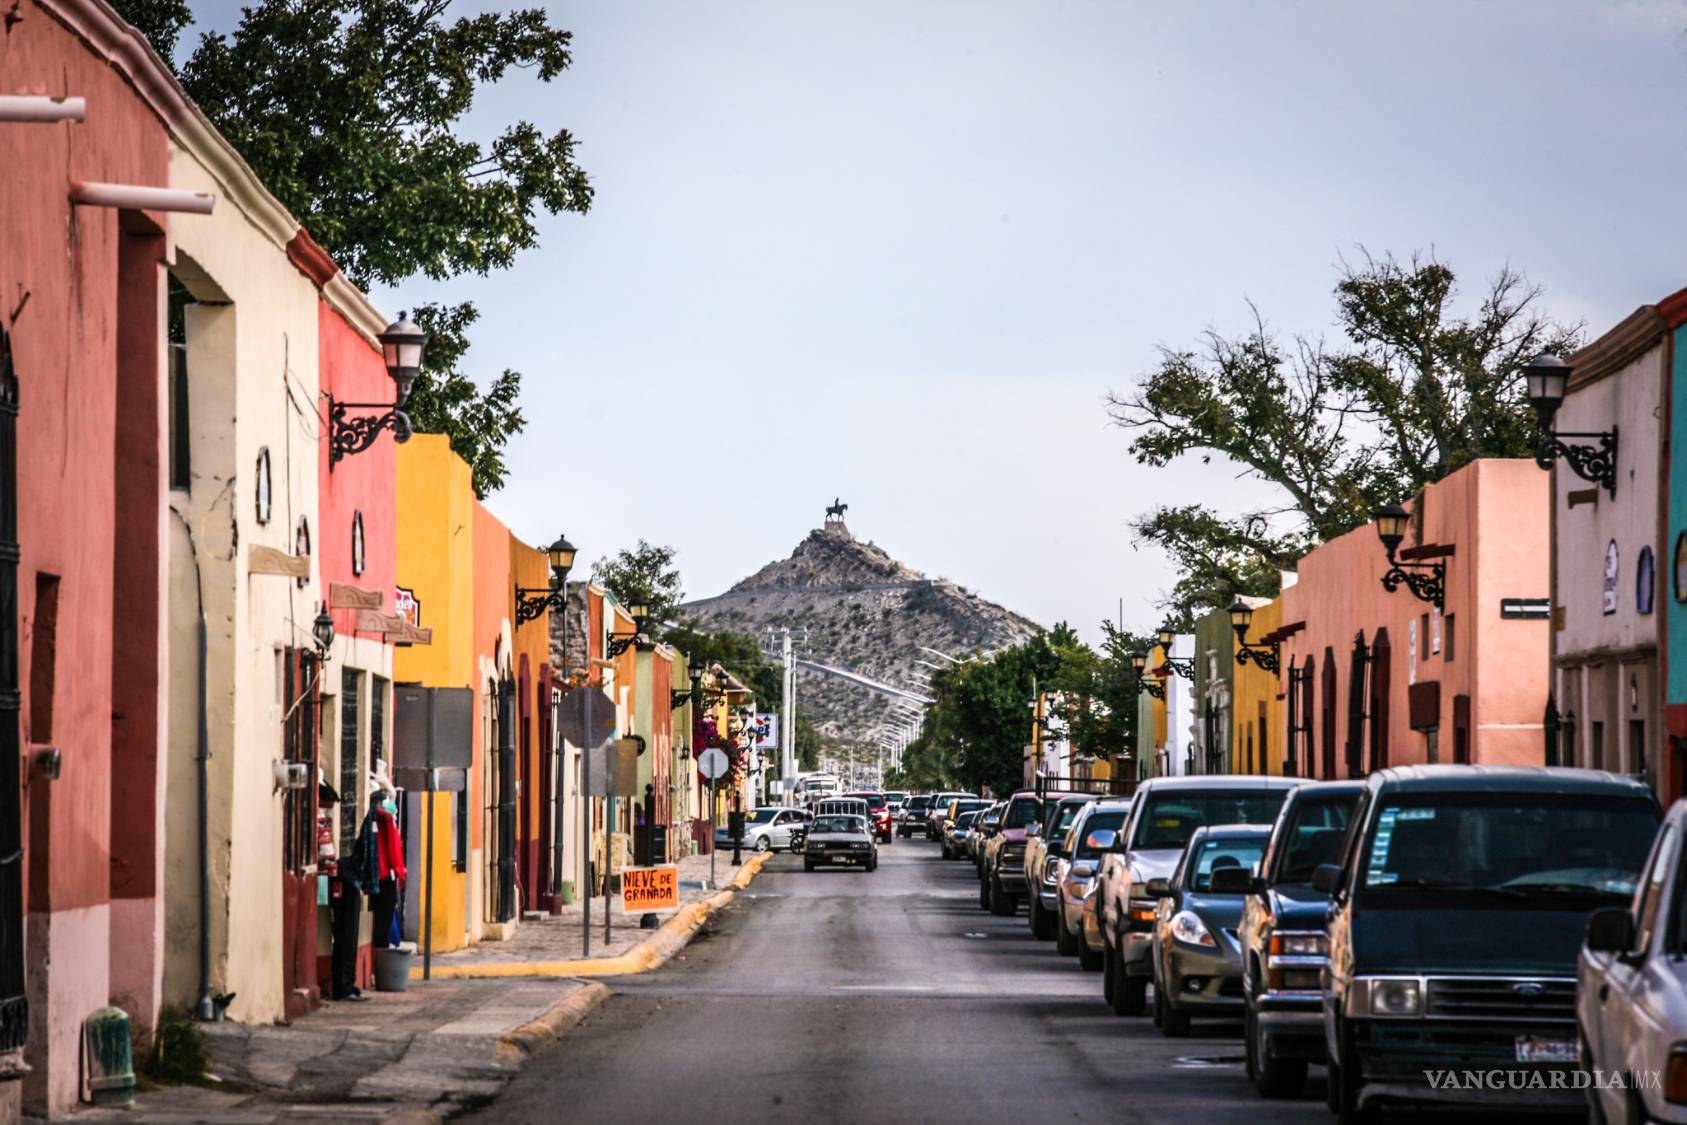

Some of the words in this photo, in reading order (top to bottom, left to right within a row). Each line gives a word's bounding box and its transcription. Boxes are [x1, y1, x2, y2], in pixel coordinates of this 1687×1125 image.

[624, 869, 657, 888] NIEVE
[660, 873, 672, 884] DE
[624, 887, 672, 902] GRANADA
